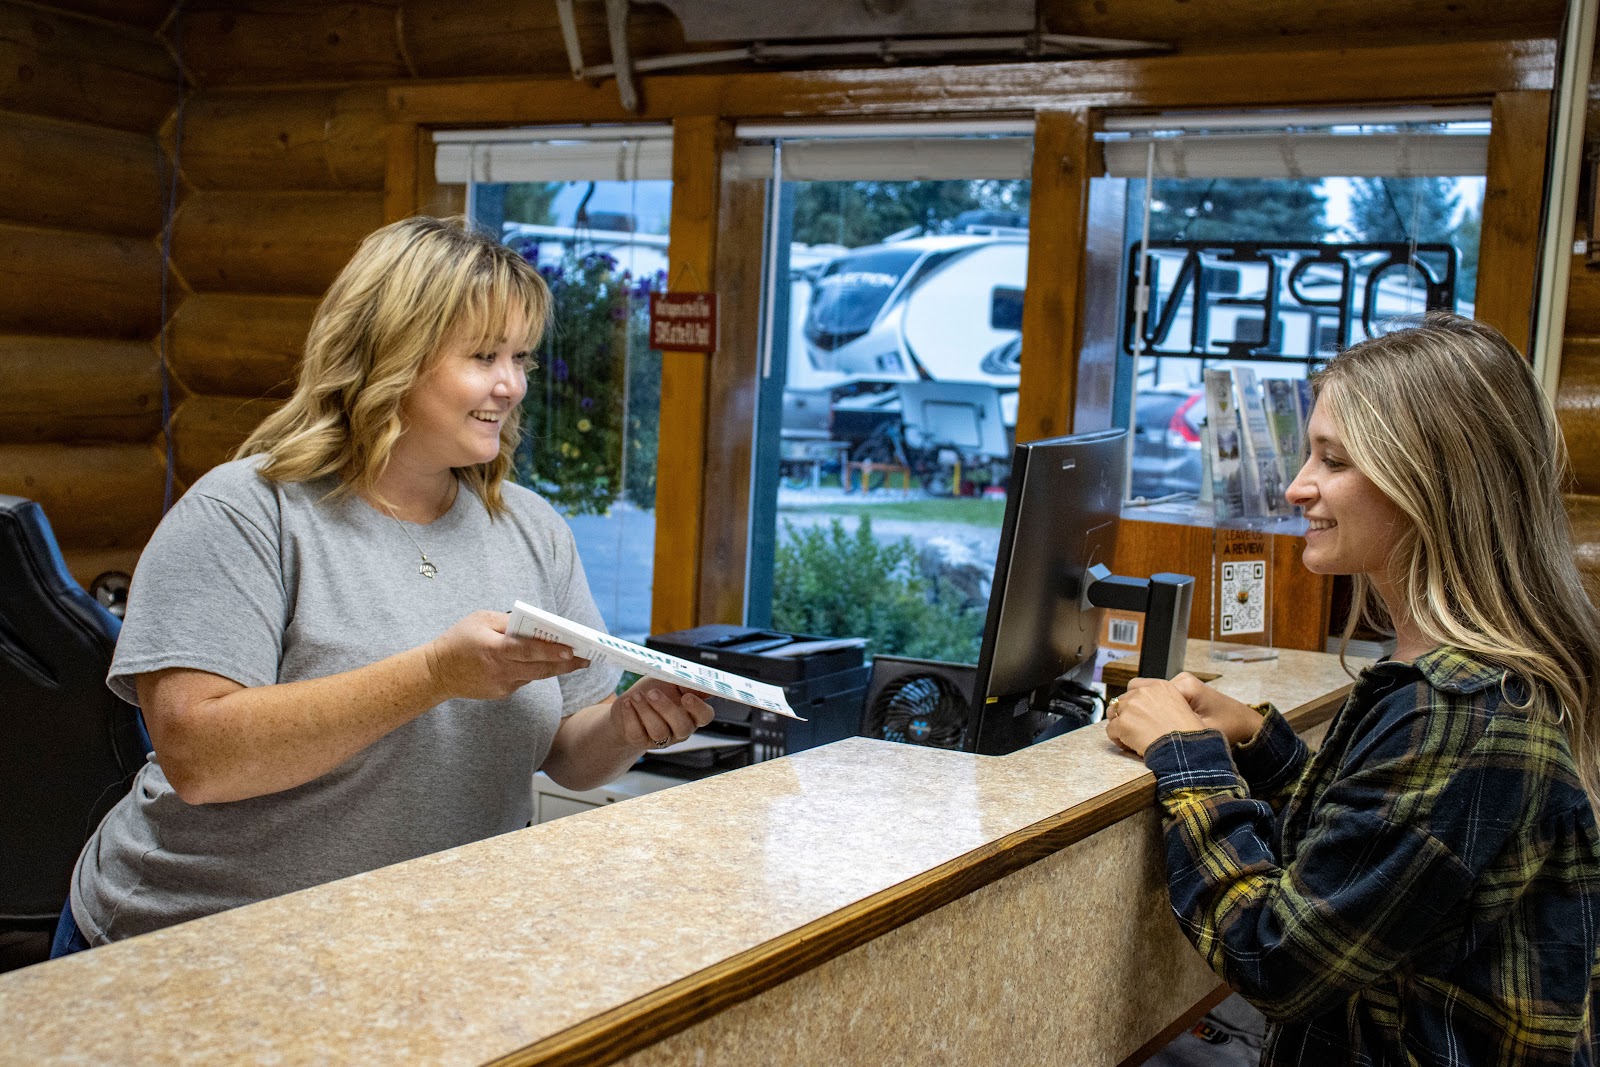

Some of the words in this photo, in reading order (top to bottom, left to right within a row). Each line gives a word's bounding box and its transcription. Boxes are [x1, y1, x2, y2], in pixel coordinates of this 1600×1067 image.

[1226, 529, 1250, 540] LEAVE
[1223, 543, 1231, 555] A
[1232, 542, 1265, 555] REVIEW
